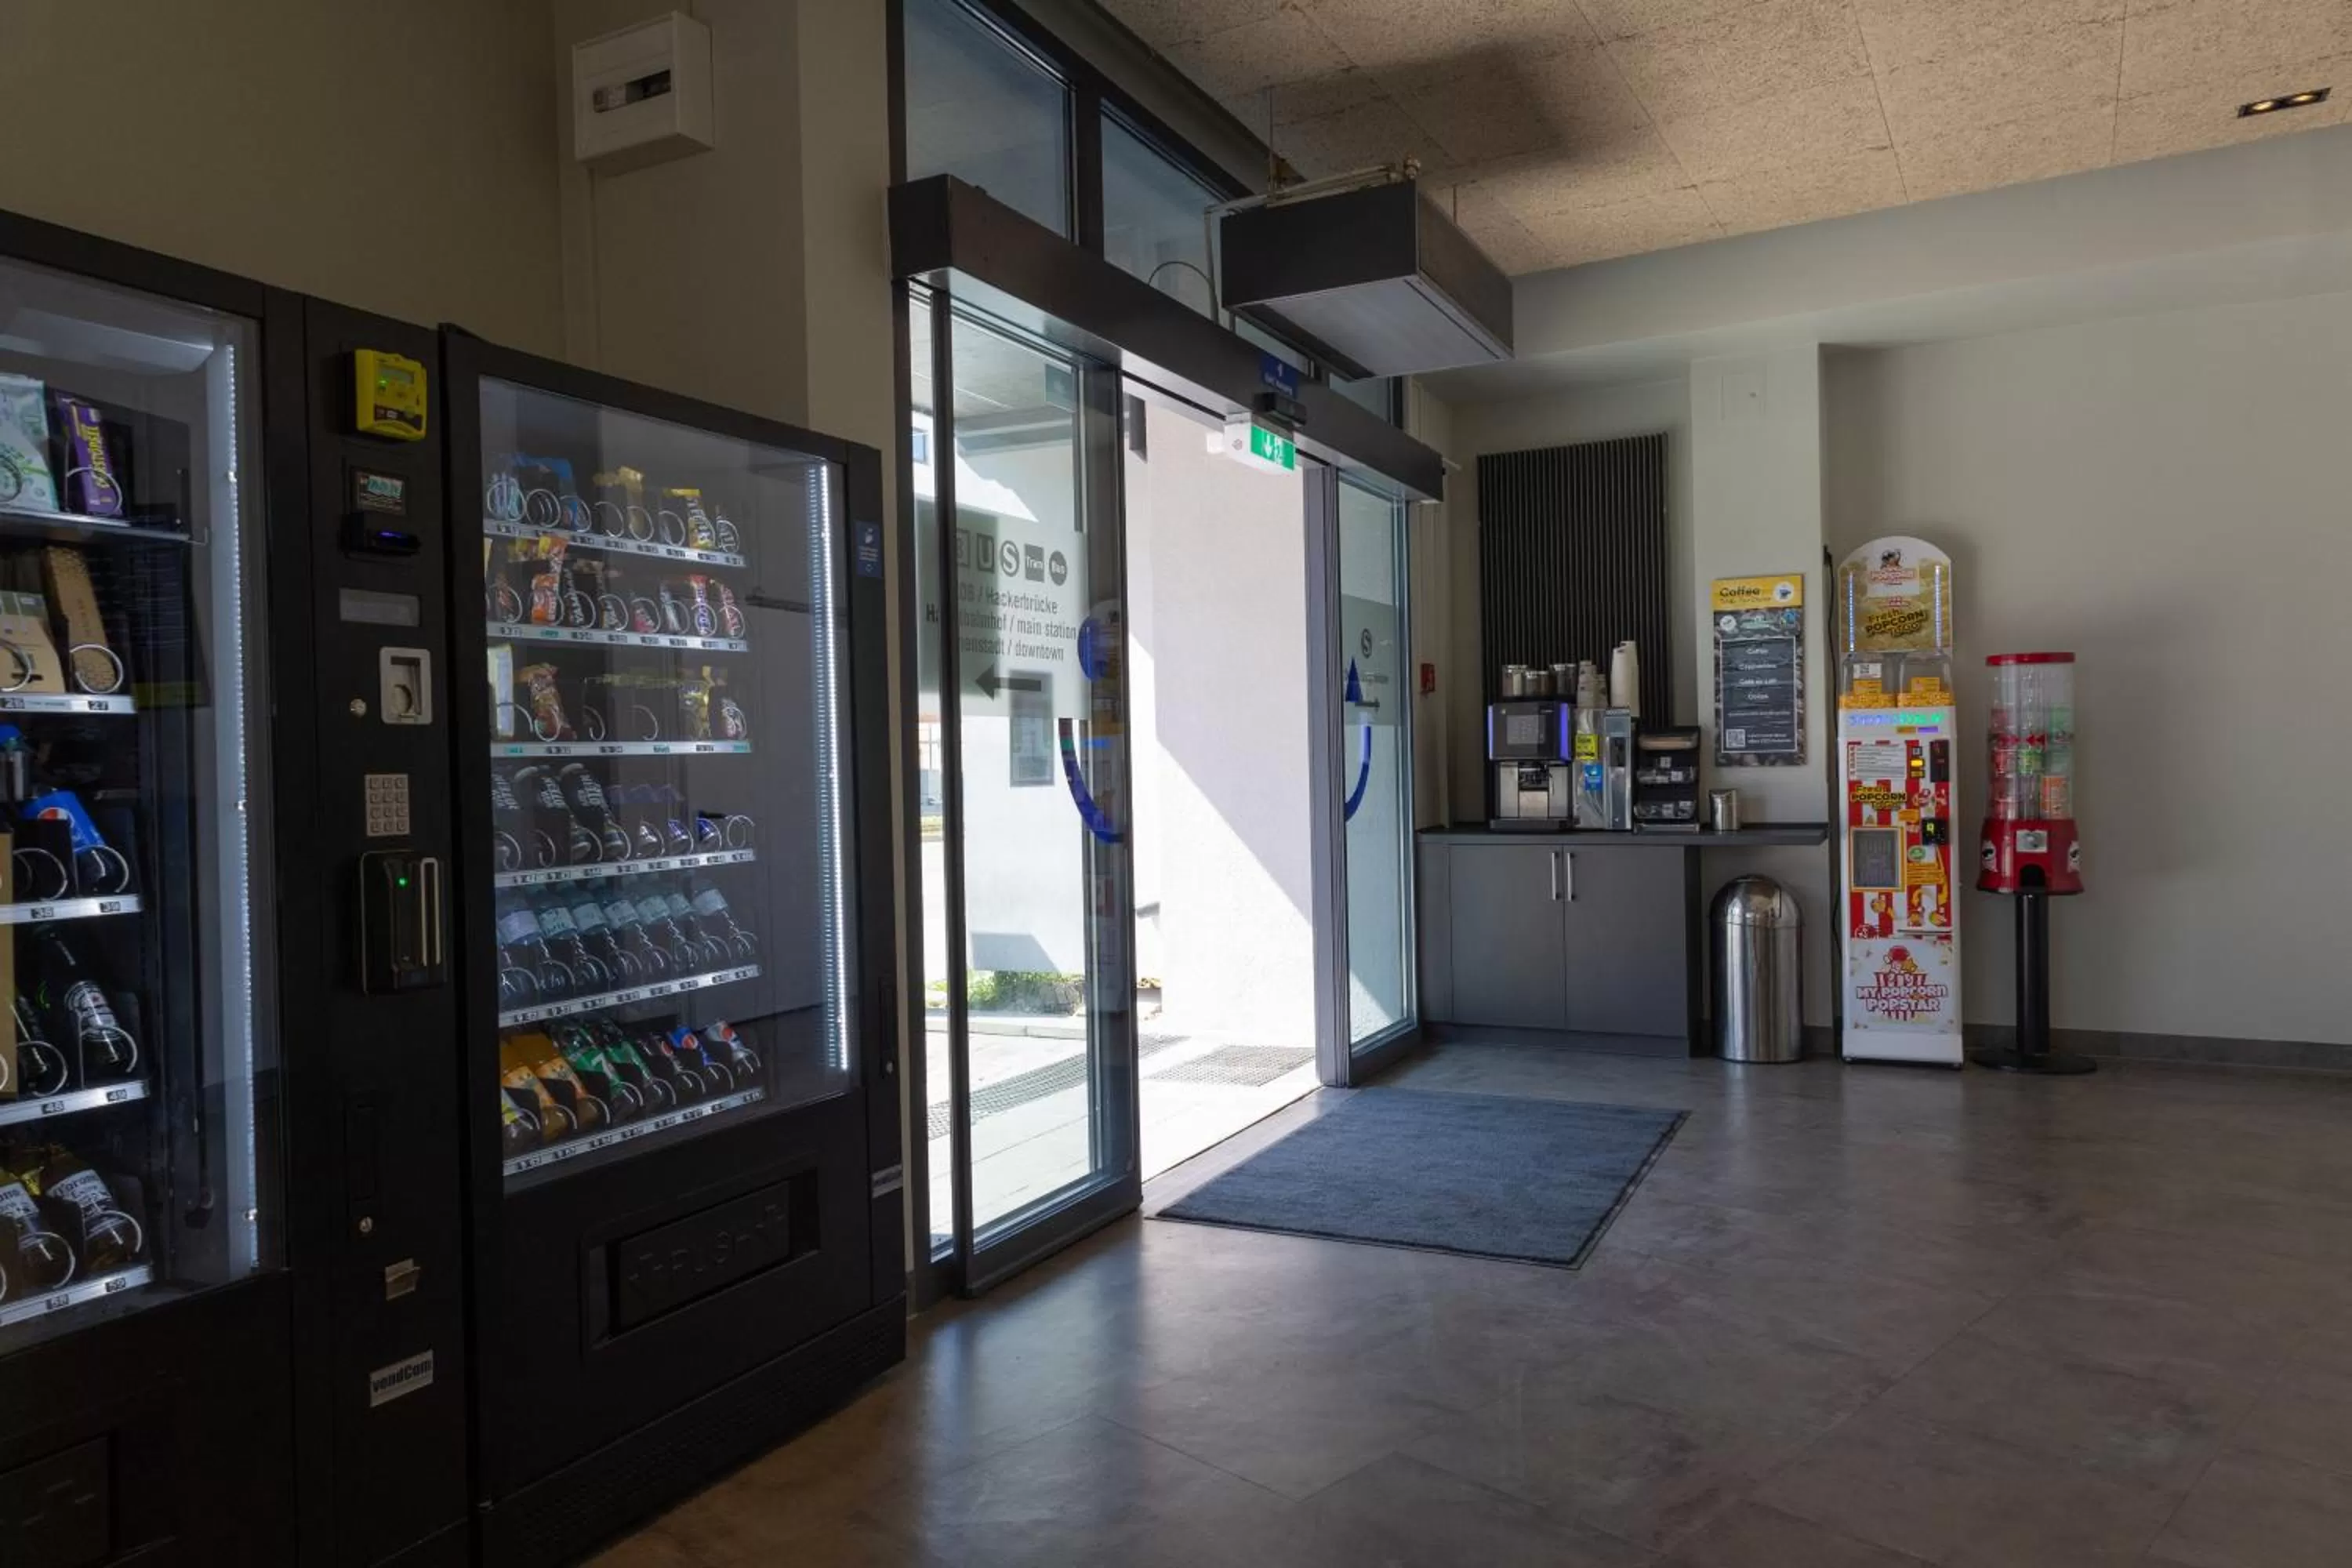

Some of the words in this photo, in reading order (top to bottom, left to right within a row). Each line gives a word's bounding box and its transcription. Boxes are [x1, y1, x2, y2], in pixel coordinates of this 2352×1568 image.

[979, 535, 993, 571] U
[1002, 542, 1018, 575] S
[985, 587, 1058, 614] Hackerbrücke
[1017, 617, 1042, 636] main
[1044, 619, 1076, 641] station
[1865, 610, 1926, 633] POPCORN
[1016, 641, 1064, 662] downtown
[1851, 792, 1907, 801] POPCORN
[1857, 986, 1879, 999] MY
[1880, 985, 1947, 1000] POPCORN
[1867, 999, 1940, 1011] POPSTAR
